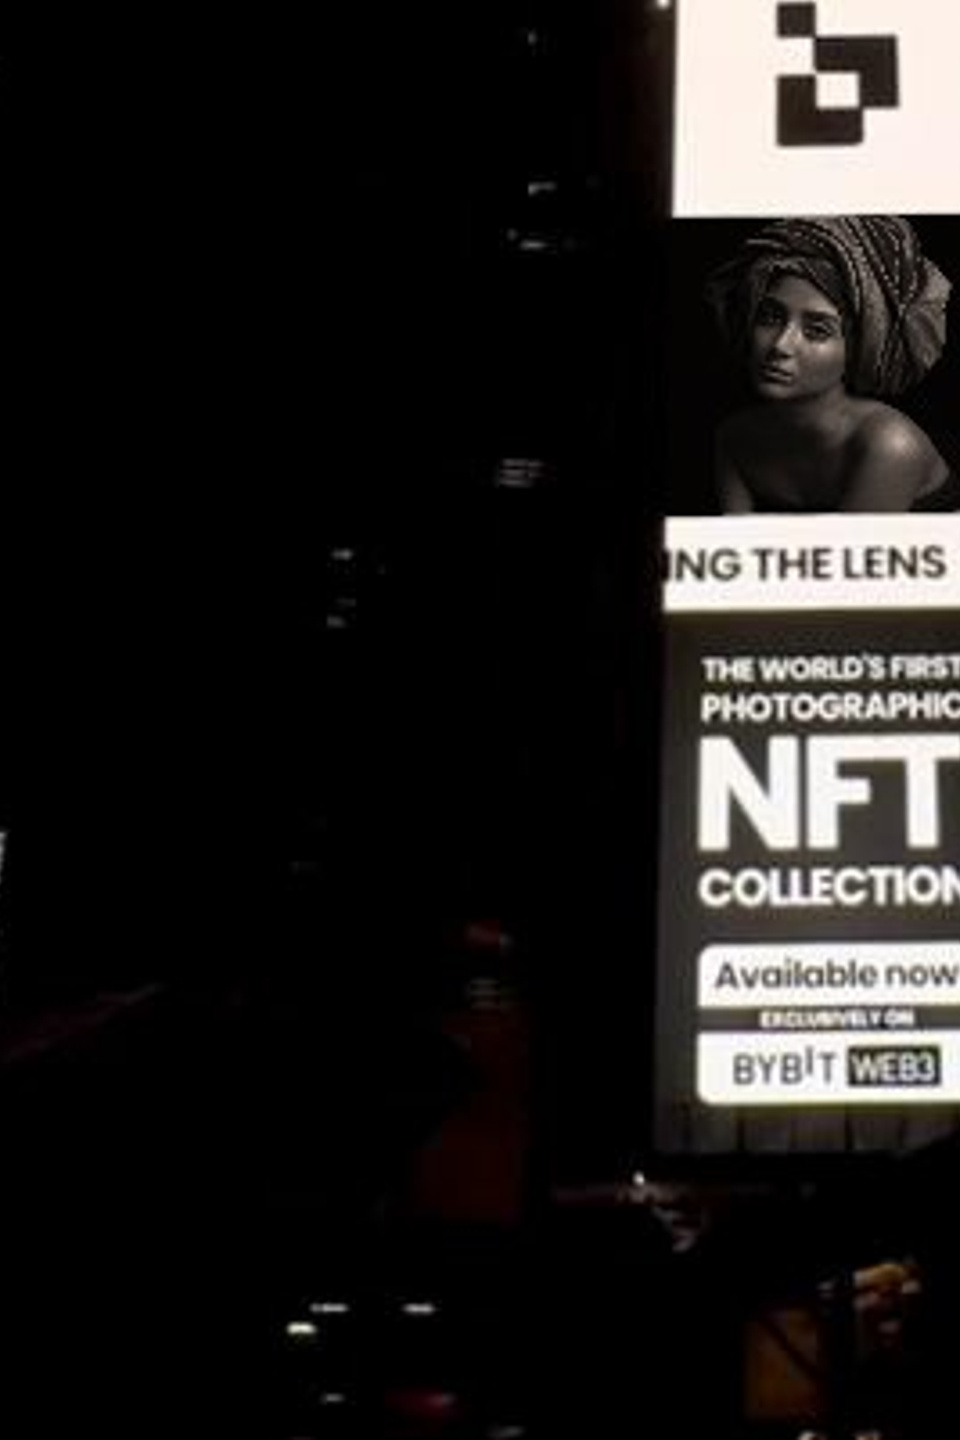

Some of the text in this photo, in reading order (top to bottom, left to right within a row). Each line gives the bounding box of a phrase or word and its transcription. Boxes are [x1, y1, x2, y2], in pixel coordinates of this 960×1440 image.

[753, 547, 831, 580] THE
[843, 545, 946, 579] LENS
[702, 656, 755, 682] THE
[758, 654, 886, 681] WORLD'S
[715, 959, 959, 989] Available now
[850, 1050, 937, 1083] WEB3
